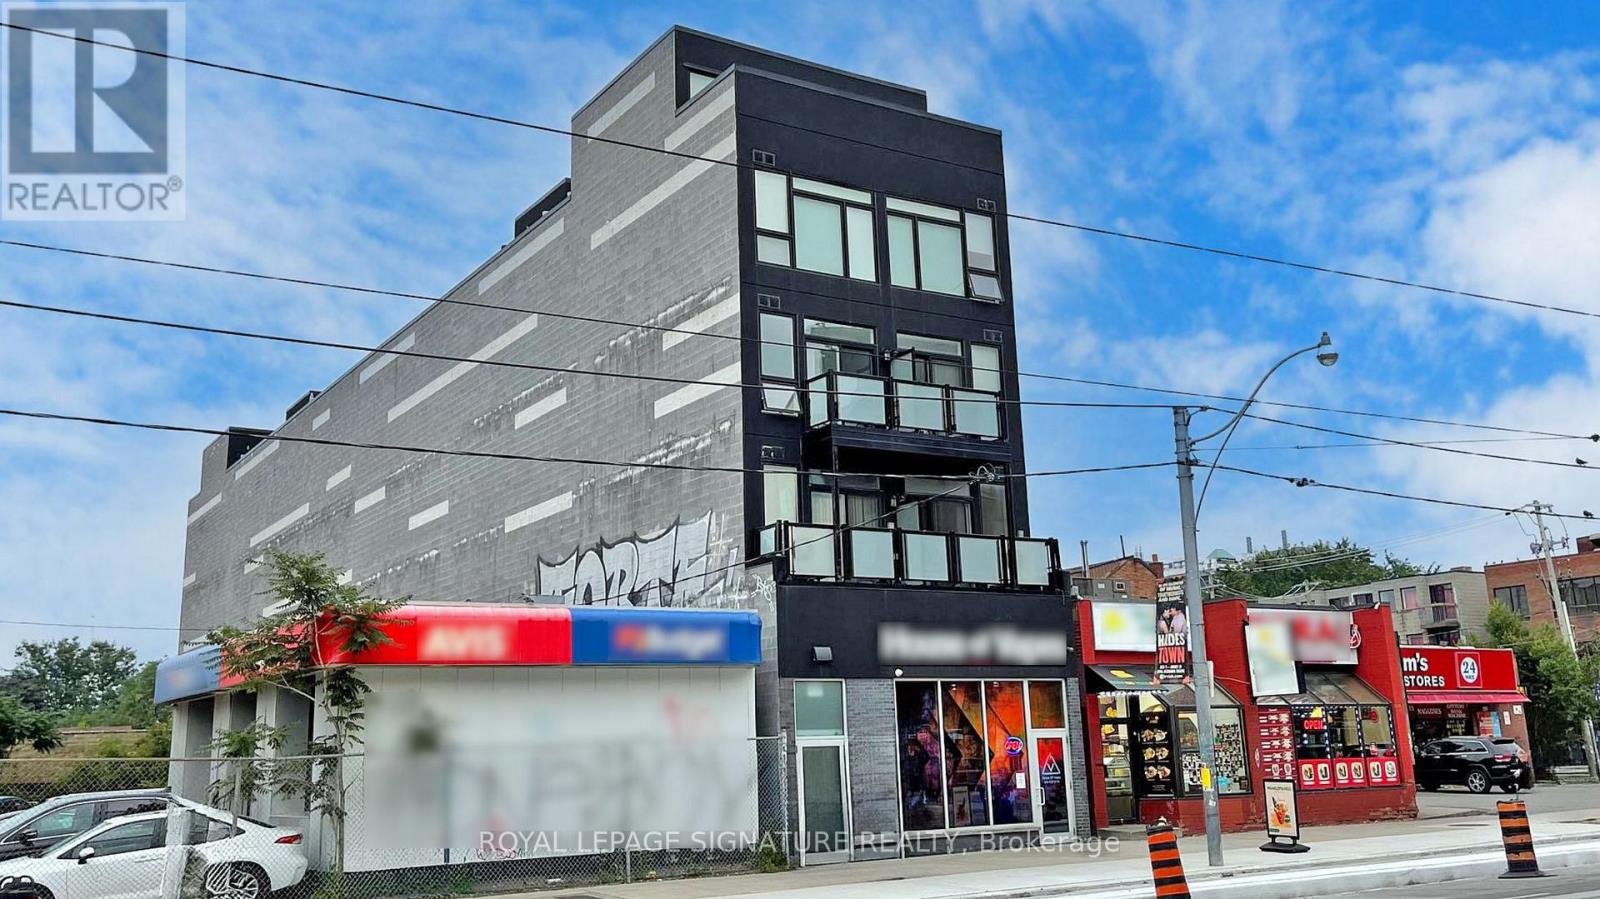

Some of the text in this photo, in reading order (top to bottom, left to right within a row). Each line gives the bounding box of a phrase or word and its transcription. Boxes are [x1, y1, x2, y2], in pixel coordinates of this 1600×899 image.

[1158, 646, 1185, 664] TOWN
[1462, 661, 1476, 674] 24
[1403, 675, 1445, 687] STORES
[1303, 719, 1324, 730] OPEN
